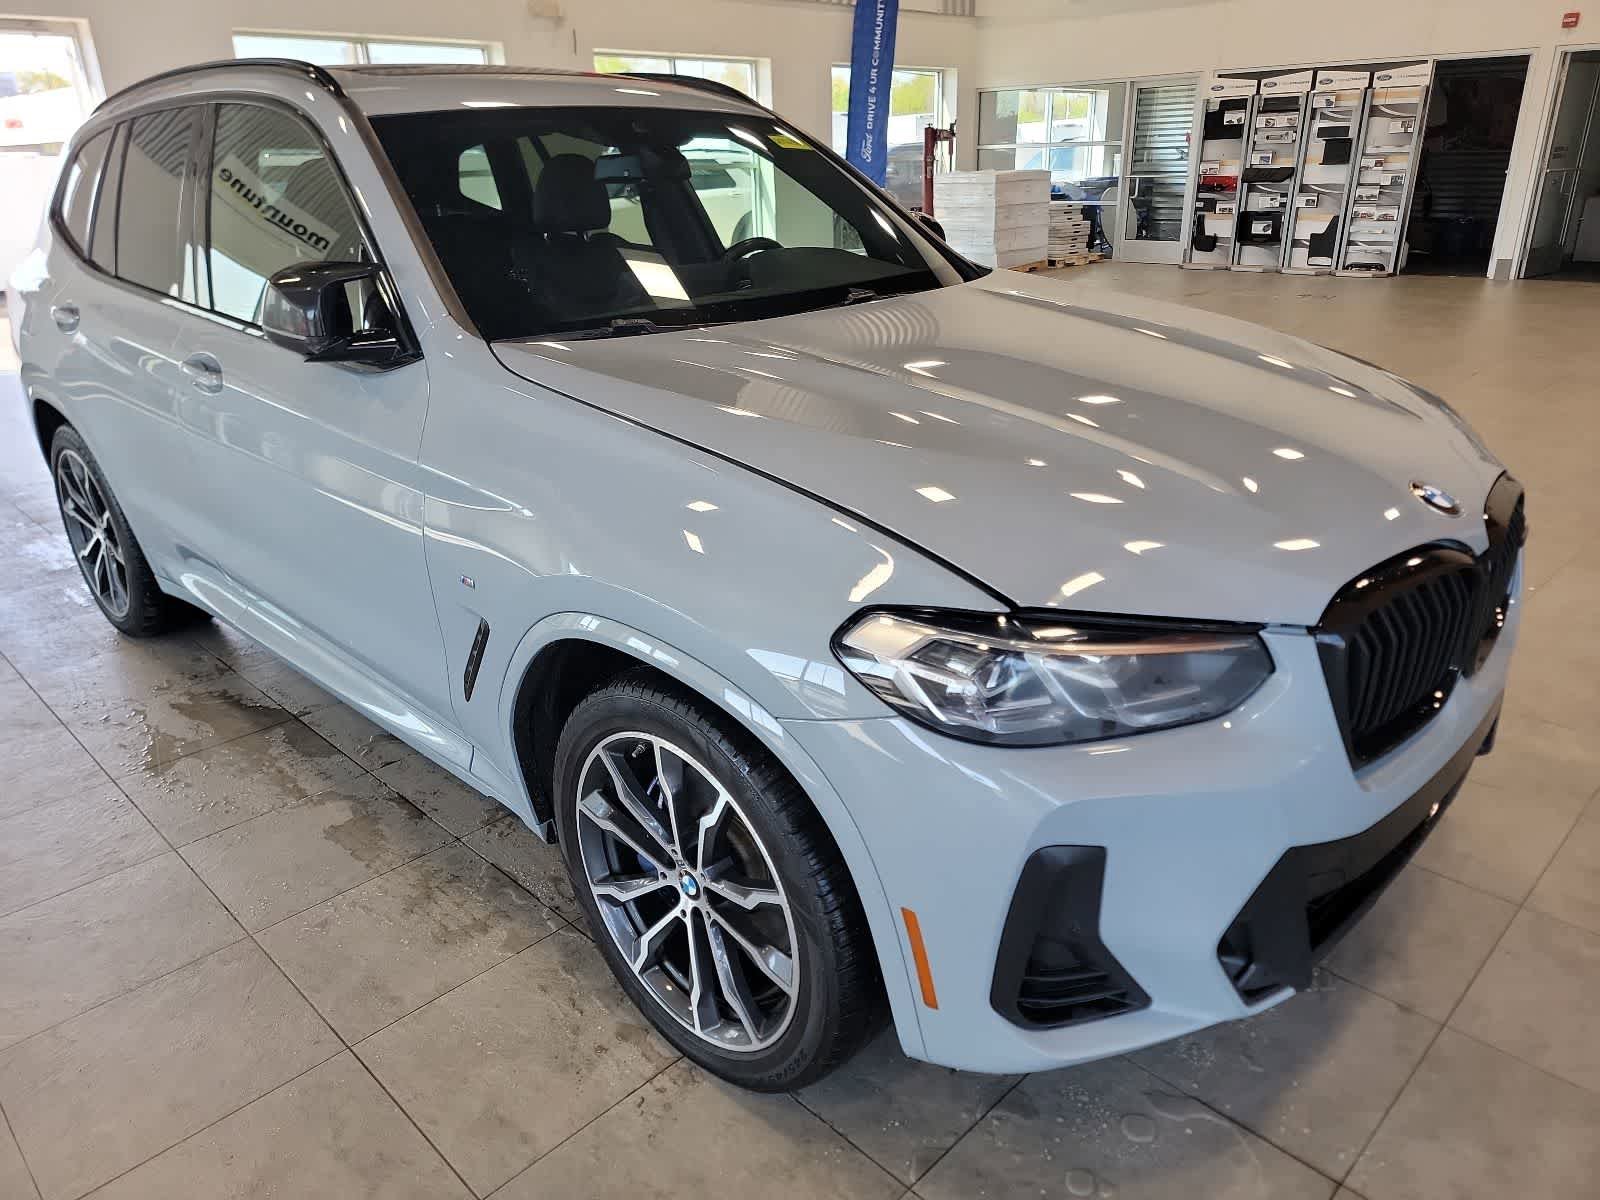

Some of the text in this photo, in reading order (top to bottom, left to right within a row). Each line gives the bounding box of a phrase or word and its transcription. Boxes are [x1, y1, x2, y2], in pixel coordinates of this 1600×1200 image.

[861, 0, 886, 163] Ford DRIVE 4 UR COMMUNIT
